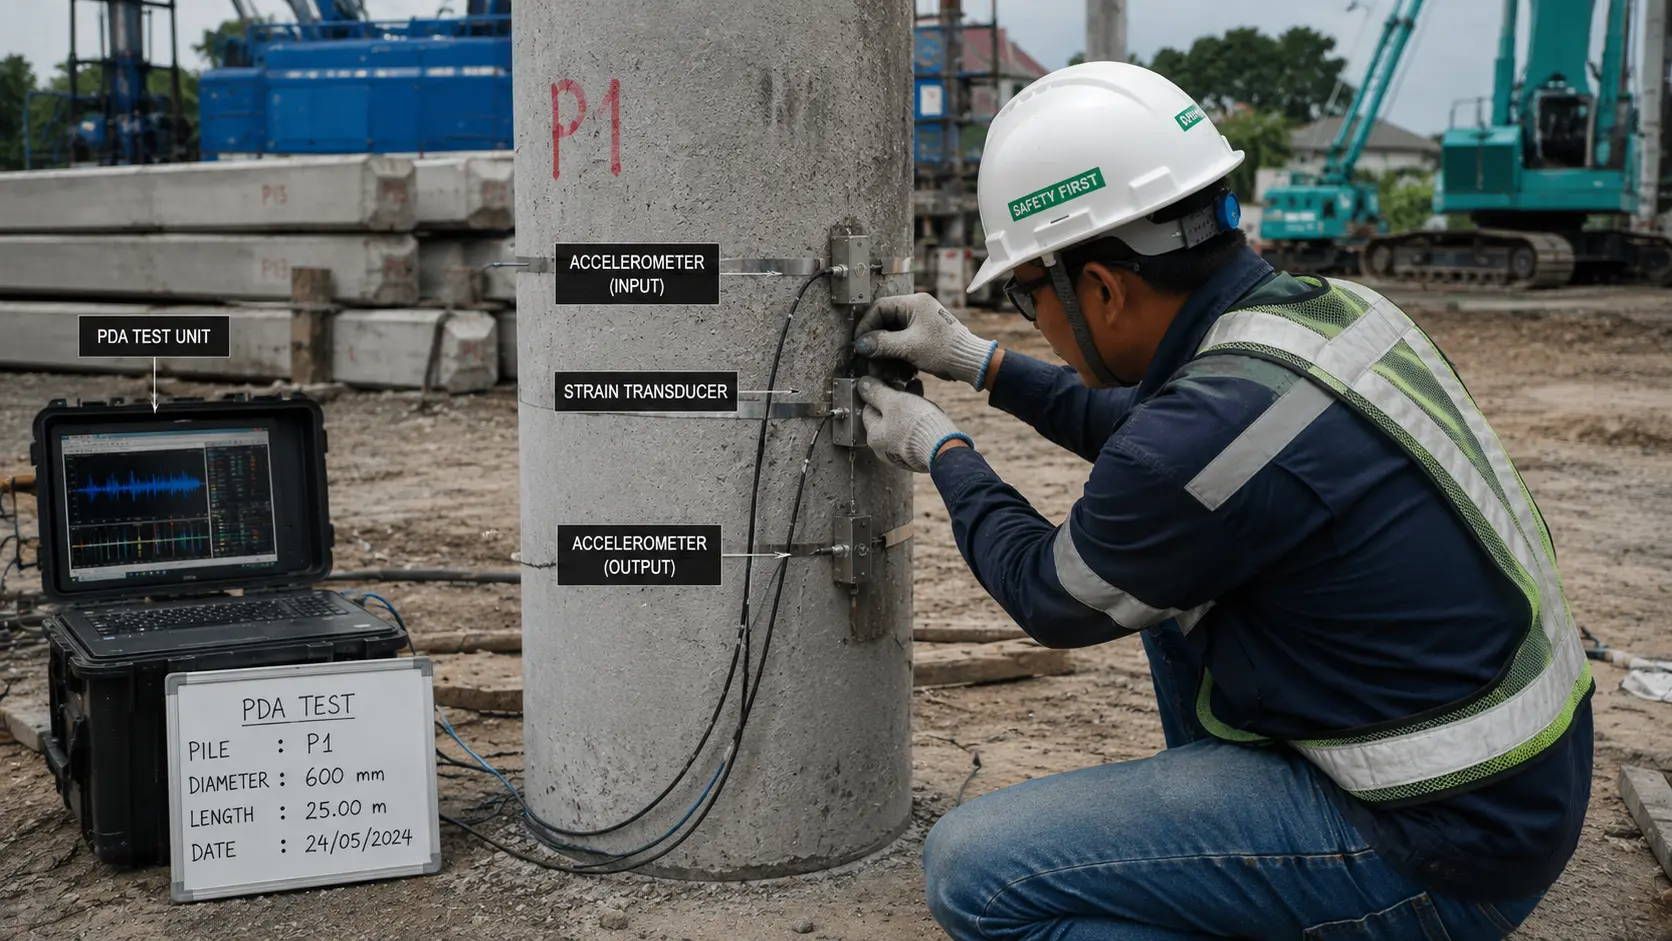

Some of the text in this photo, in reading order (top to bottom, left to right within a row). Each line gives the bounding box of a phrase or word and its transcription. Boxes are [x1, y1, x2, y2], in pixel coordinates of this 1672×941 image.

[551, 78, 622, 180] P1
[1013, 173, 1098, 216] SAFETY FIRST
[243, 693, 355, 721] PDA TEST
[189, 741, 229, 761] PILE
[308, 733, 332, 754] P1
[189, 772, 269, 794] DIAMETER
[306, 767, 343, 786] 600
[357, 770, 384, 782] mm
[191, 806, 253, 827] LENGTH
[306, 800, 361, 820] 25.00
[373, 803, 386, 813] m
[192, 841, 236, 862] DATE
[305, 827, 412, 854] 24/05/2024
